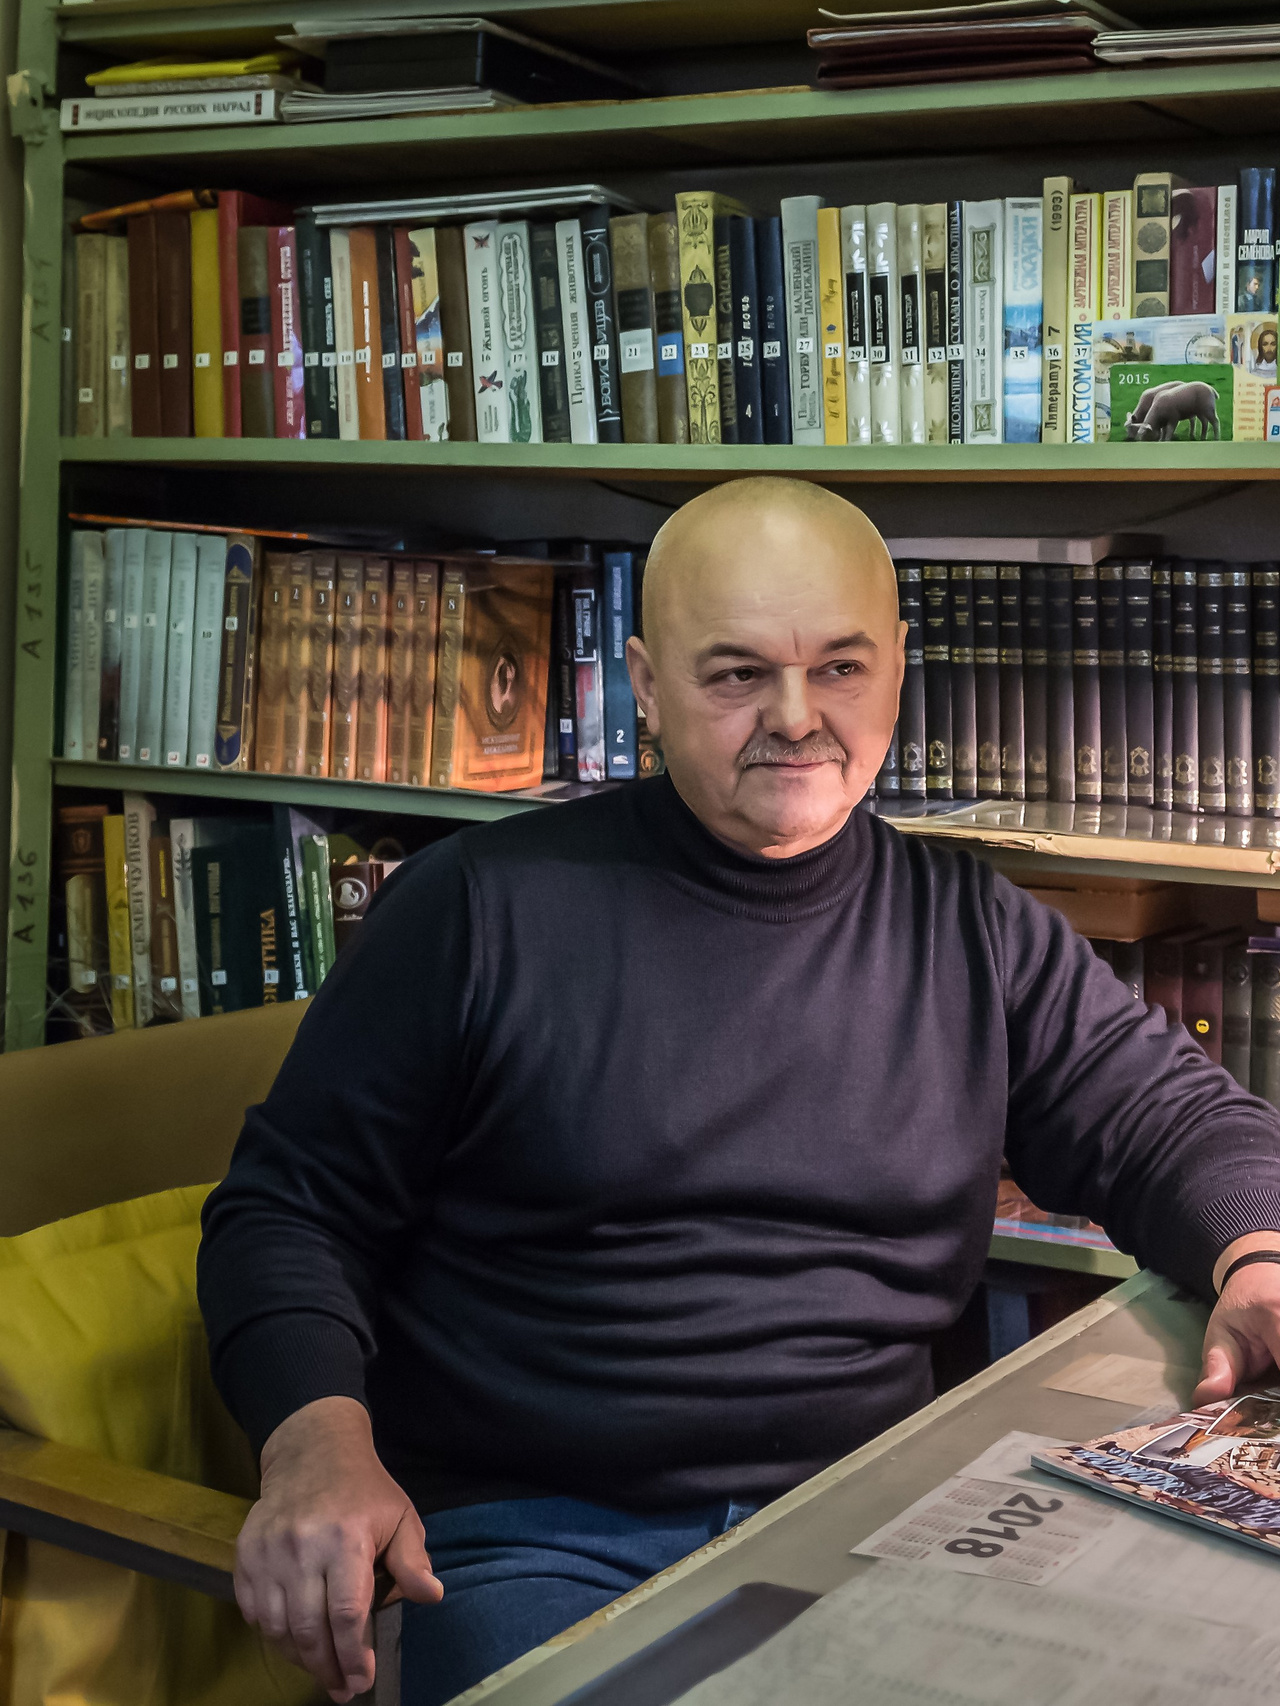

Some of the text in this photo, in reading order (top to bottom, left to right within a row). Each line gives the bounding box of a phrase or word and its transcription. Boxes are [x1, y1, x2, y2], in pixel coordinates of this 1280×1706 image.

[1244, 229, 1269, 243] МАРИЯ
[1022, 216, 1039, 291] СКАЗКИ
[1074, 199, 1088, 309] ЗАРУБЕЖНАЯ ЛИТЕРАТУРА
[1108, 197, 1121, 307] ЗАРУБЕЖНАЯ ЛИТЕРАТУРА
[1049, 190, 1062, 336] 7 (1993)
[804, 241, 813, 315] ПАРИЖАНИН
[481, 267, 492, 350] Живой огонь
[566, 236, 584, 405] Приклчения животных
[950, 210, 962, 436] НЕОБЫЧНЫЕ ЖИВОТНЫХ
[694, 346, 705, 355] 23
[718, 346, 729, 355] 24
[740, 344, 751, 353] 25
[766, 345, 778, 355] 26
[799, 341, 810, 350] 27
[827, 346, 839, 355] 28
[572, 351, 582, 361] 19
[596, 348, 606, 356] 20
[627, 347, 638, 357] 21
[664, 347, 674, 357] 22
[850, 351, 861, 360] 29
[931, 351, 942, 360] 32
[975, 349, 986, 357] 34
[1013, 350, 1025, 359] 35
[405, 355, 414, 363] 13
[424, 353, 433, 362] 14
[450, 355, 460, 364] 15
[481, 354, 491, 362] 16
[513, 354, 522, 364] 17
[545, 355, 555, 363] 18
[1072, 322, 1092, 443] ХРЕСТОМАИЯ
[1118, 374, 1149, 384] 2015
[616, 729, 624, 743] 2
[944, 1492, 1064, 1558] 2018
